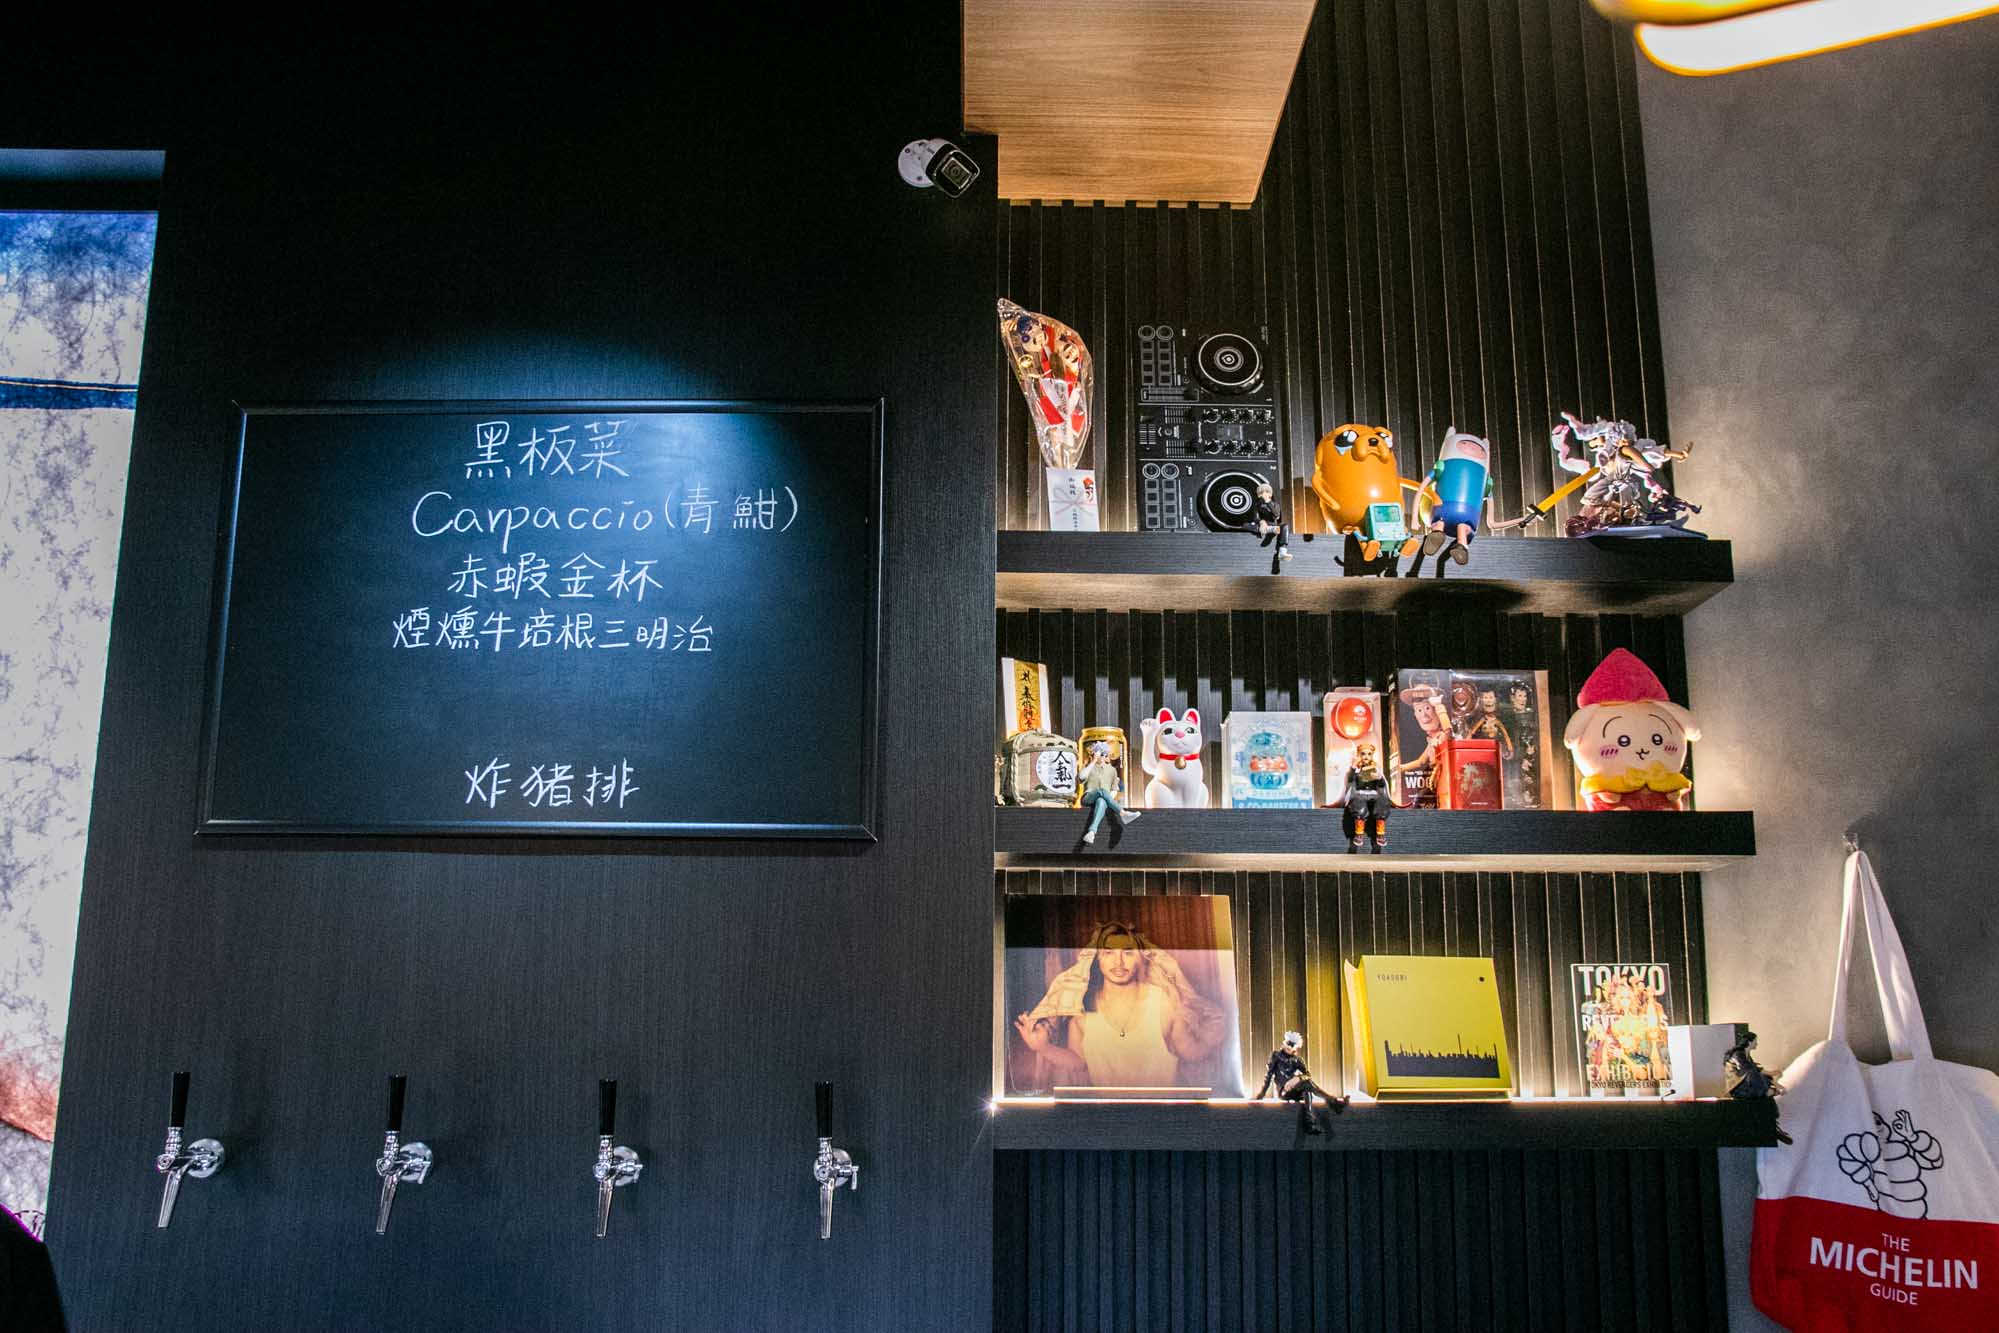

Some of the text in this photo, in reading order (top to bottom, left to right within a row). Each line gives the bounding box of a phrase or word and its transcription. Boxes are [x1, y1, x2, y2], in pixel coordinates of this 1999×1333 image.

[464, 420, 632, 480] 黑板菜
[447, 552, 664, 602] 赤蝦金杯
[1809, 1237, 1978, 1290] MICHELIN
[1882, 1233, 1911, 1252] THE
[1870, 1283, 1919, 1306] GUIDE
